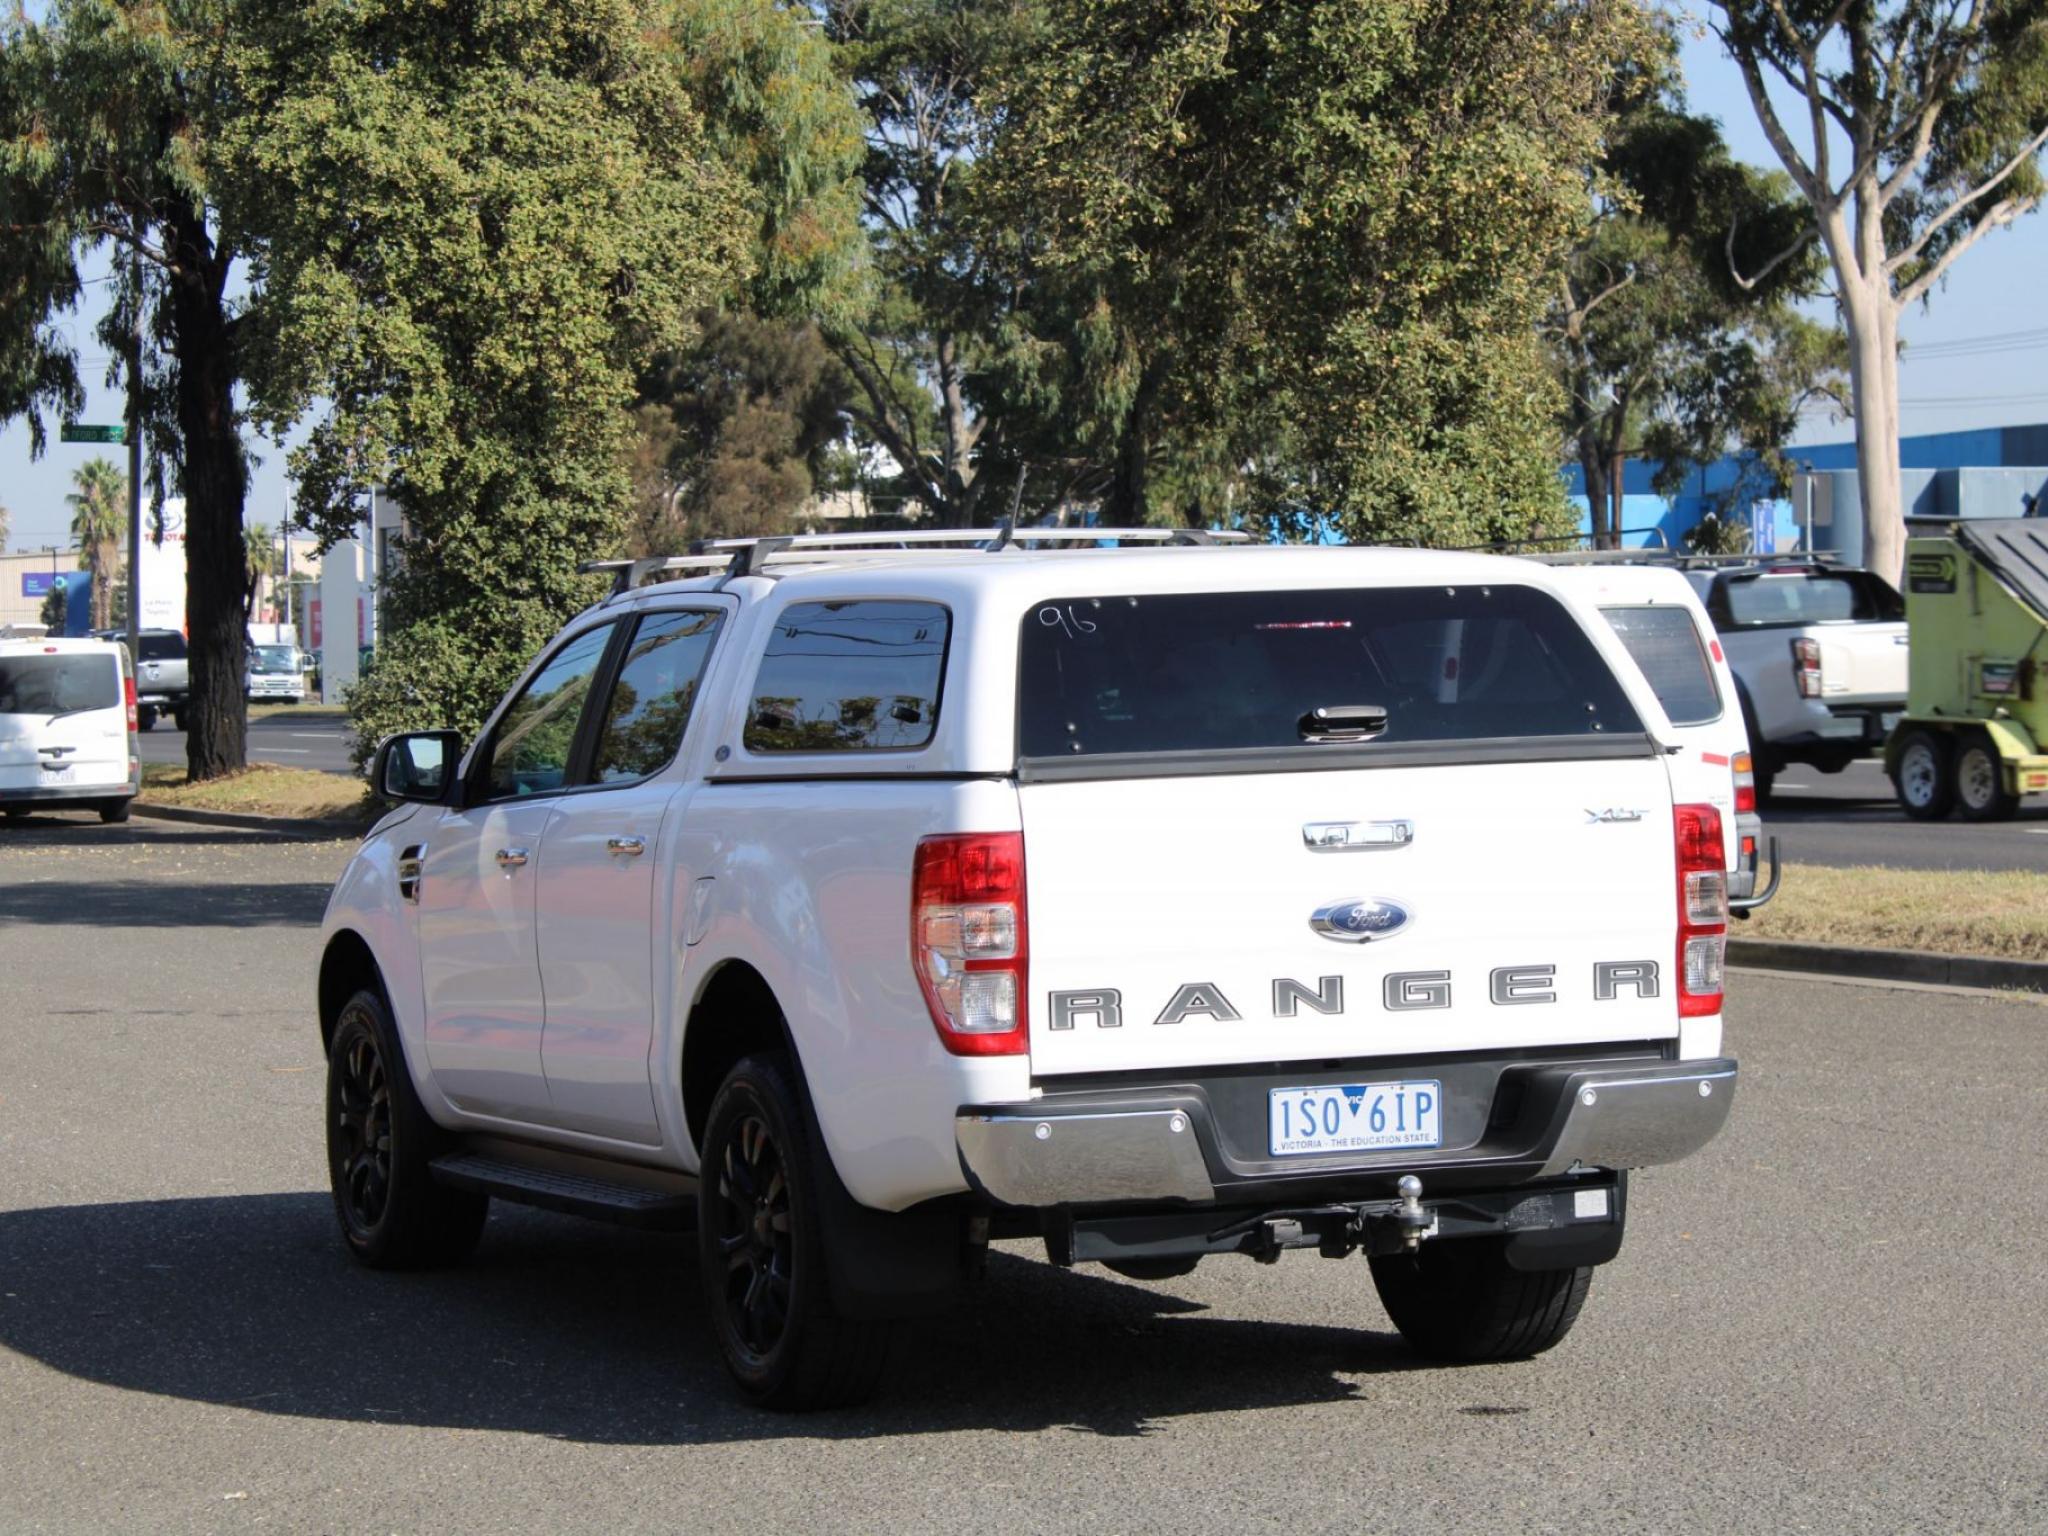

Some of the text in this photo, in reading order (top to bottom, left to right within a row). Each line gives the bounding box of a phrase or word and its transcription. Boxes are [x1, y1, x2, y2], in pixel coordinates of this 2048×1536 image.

[144, 533, 189, 542] TOOTA
[1040, 605, 1097, 639] 96
[1584, 807, 1650, 824] XLT
[1347, 906, 1391, 929] Ford
[1048, 960, 1660, 1031] RANGER
[1281, 1139, 1322, 1151] VICTORIA
[1331, 1137, 1348, 1147] THE
[1350, 1134, 1401, 1146] EDUCATION
[1404, 1132, 1431, 1143] STATE
